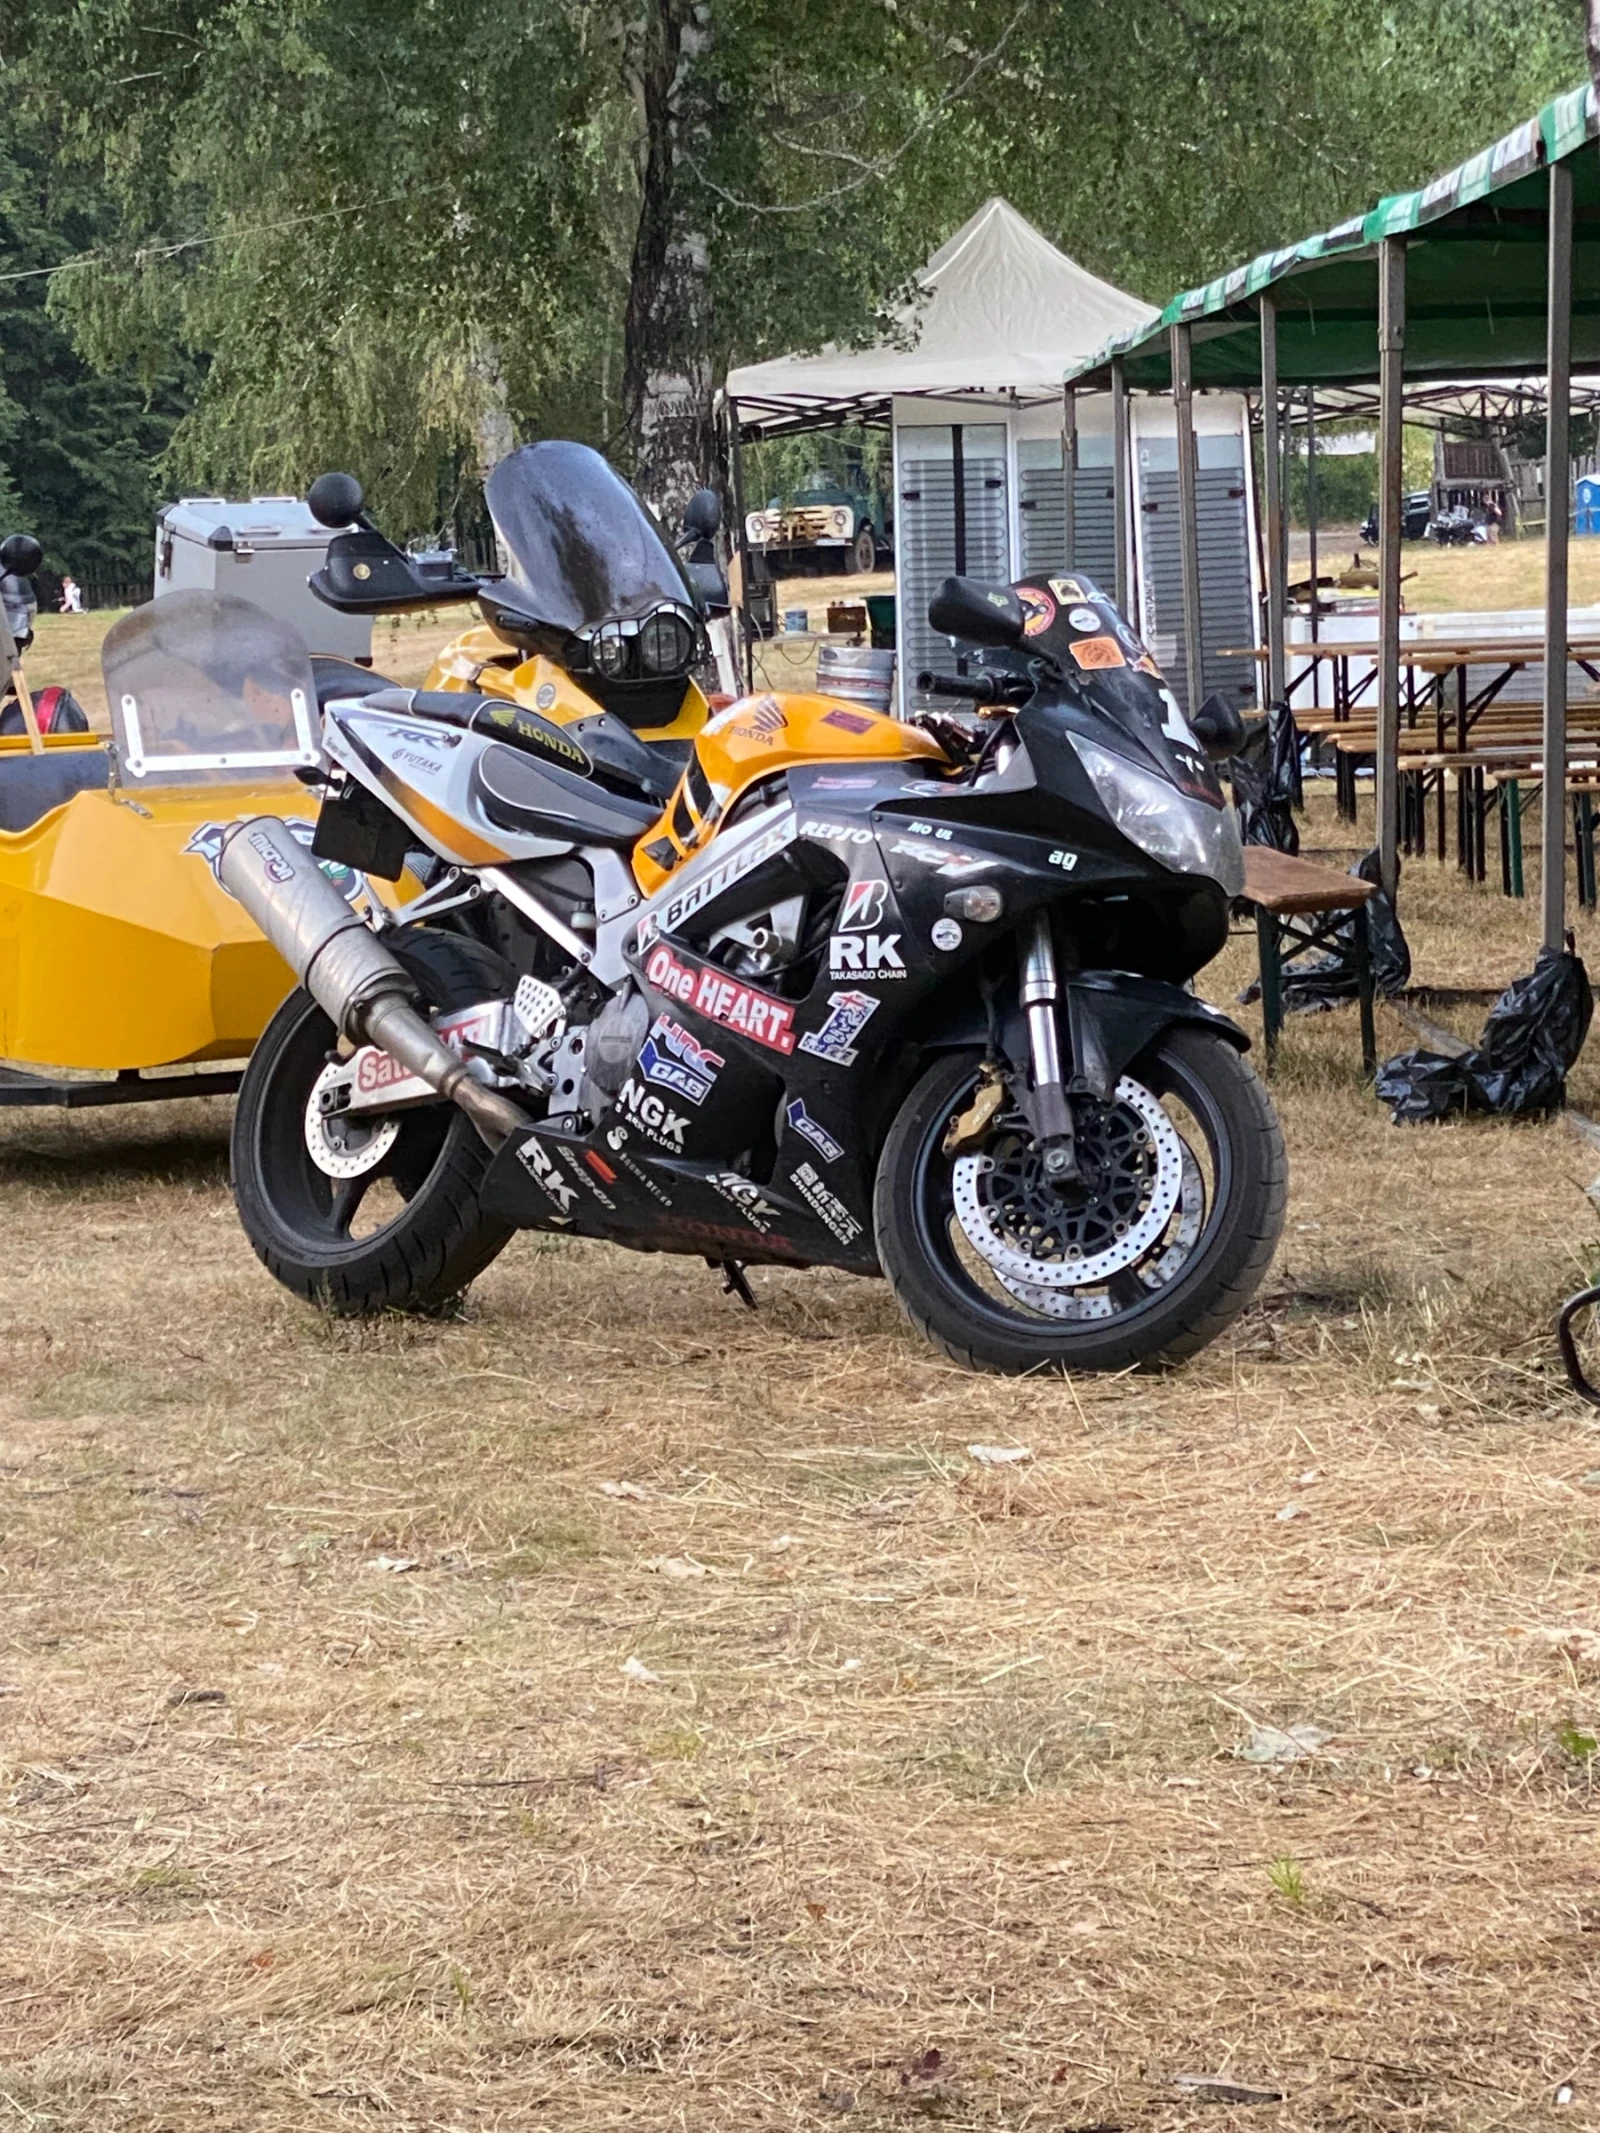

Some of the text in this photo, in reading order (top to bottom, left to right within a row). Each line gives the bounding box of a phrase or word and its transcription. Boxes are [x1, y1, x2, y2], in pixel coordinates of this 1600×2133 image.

[516, 719, 585, 765] HONDA
[728, 725, 774, 747] HONDA
[403, 750, 443, 772] YUTAKA
[799, 820, 882, 844] REPSO
[907, 821, 953, 841] MOUL
[829, 934, 906, 970] RK
[829, 968, 907, 981] TAKASAGO CHAIN
[648, 950, 791, 1049] One HEART.
[649, 1061, 705, 1099] GAS
[615, 1102, 683, 1155] SARK PLUGS
[618, 1077, 692, 1146] NGK
[795, 1118, 839, 1158] GAS
[519, 1136, 580, 1211] RK
[556, 1145, 617, 1210] Snap-on
[788, 1172, 850, 1246] SHINDENGEN
